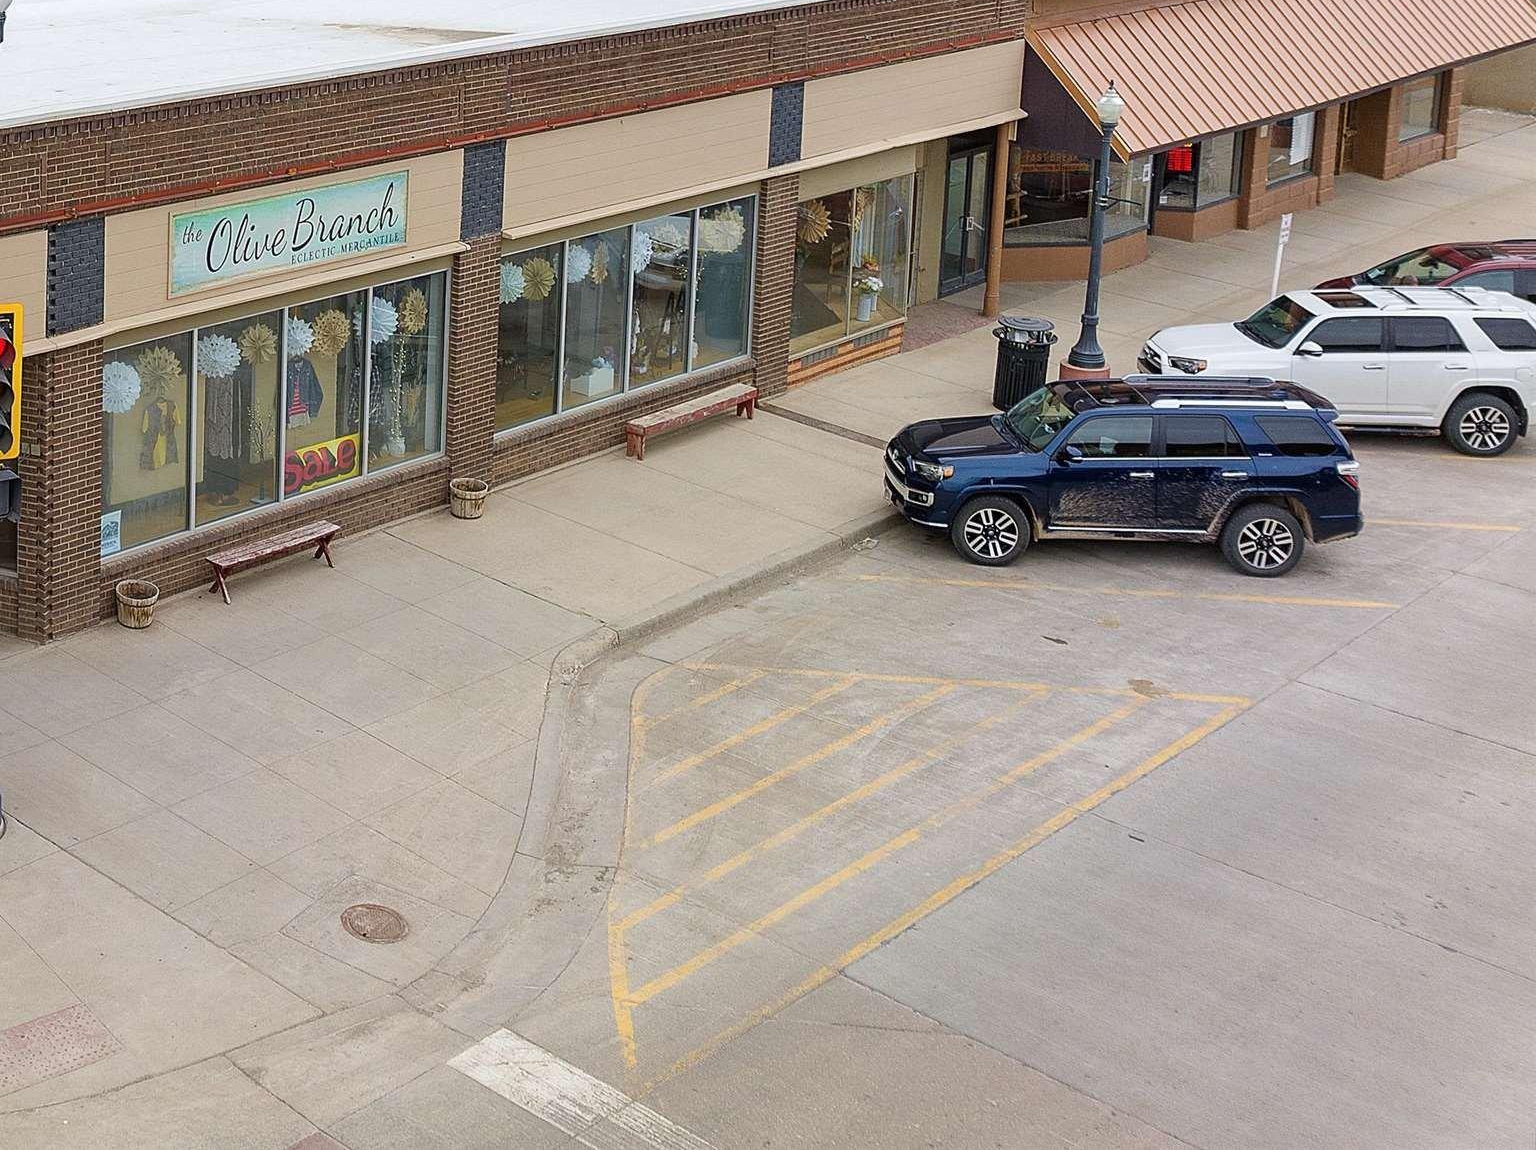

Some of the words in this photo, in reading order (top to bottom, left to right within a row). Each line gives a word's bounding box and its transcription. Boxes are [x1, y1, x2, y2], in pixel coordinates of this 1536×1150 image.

[182, 221, 203, 246] the
[206, 212, 287, 273] Olive
[291, 182, 400, 252] Branch
[291, 246, 337, 265] ECLECTIC
[340, 232, 401, 254] MERCANTILE
